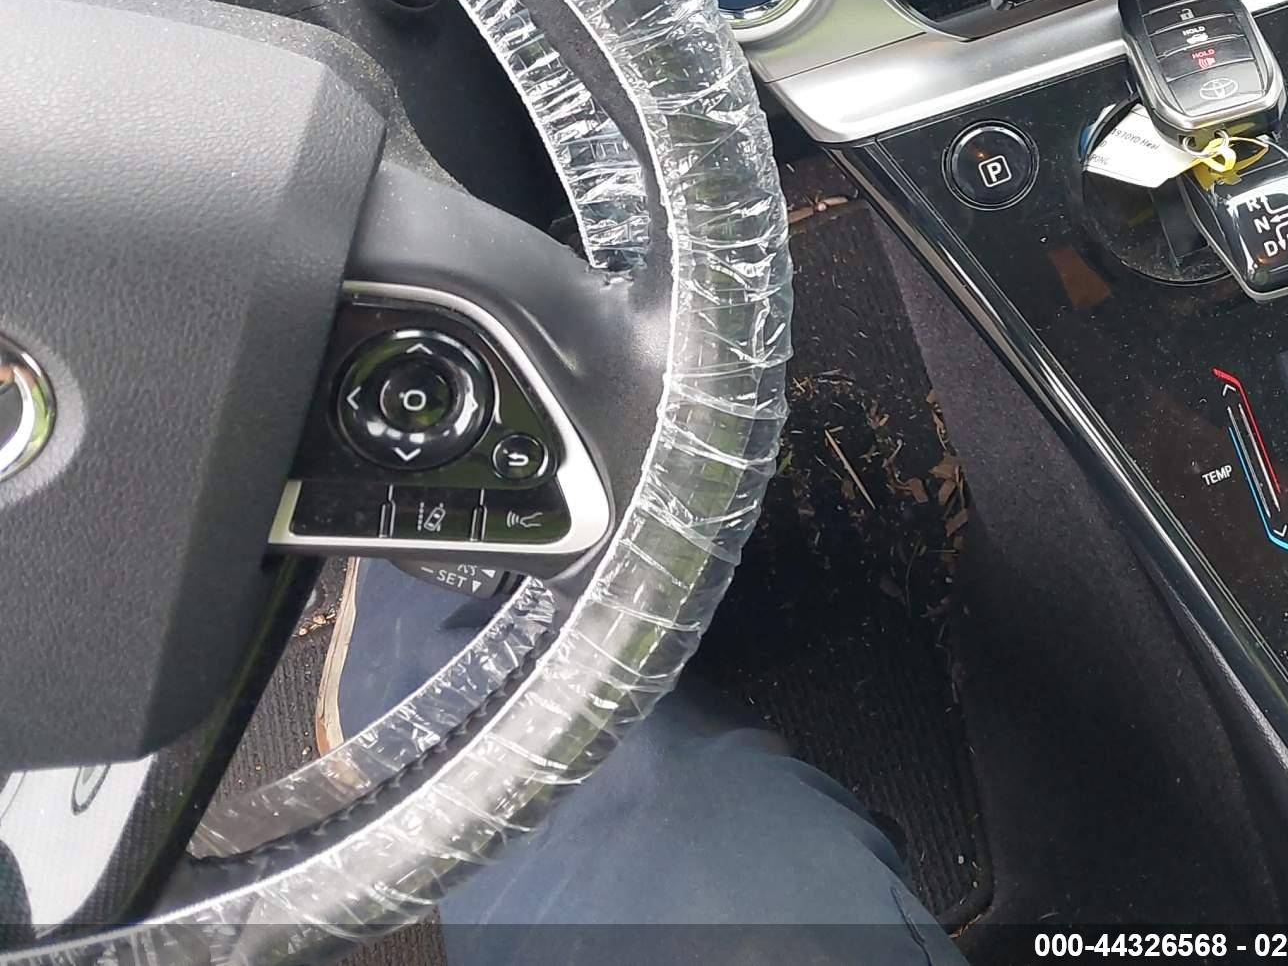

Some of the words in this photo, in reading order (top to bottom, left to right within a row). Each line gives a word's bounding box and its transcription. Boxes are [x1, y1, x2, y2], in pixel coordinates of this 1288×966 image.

[1182, 26, 1206, 36] HOLD
[1192, 49, 1216, 59] HOLD
[987, 162, 1002, 182] P
[1246, 197, 1261, 212] R
[1253, 216, 1271, 234] N
[1263, 240, 1279, 257] D
[1202, 464, 1233, 486] TEMP
[436, 569, 468, 588] SET
